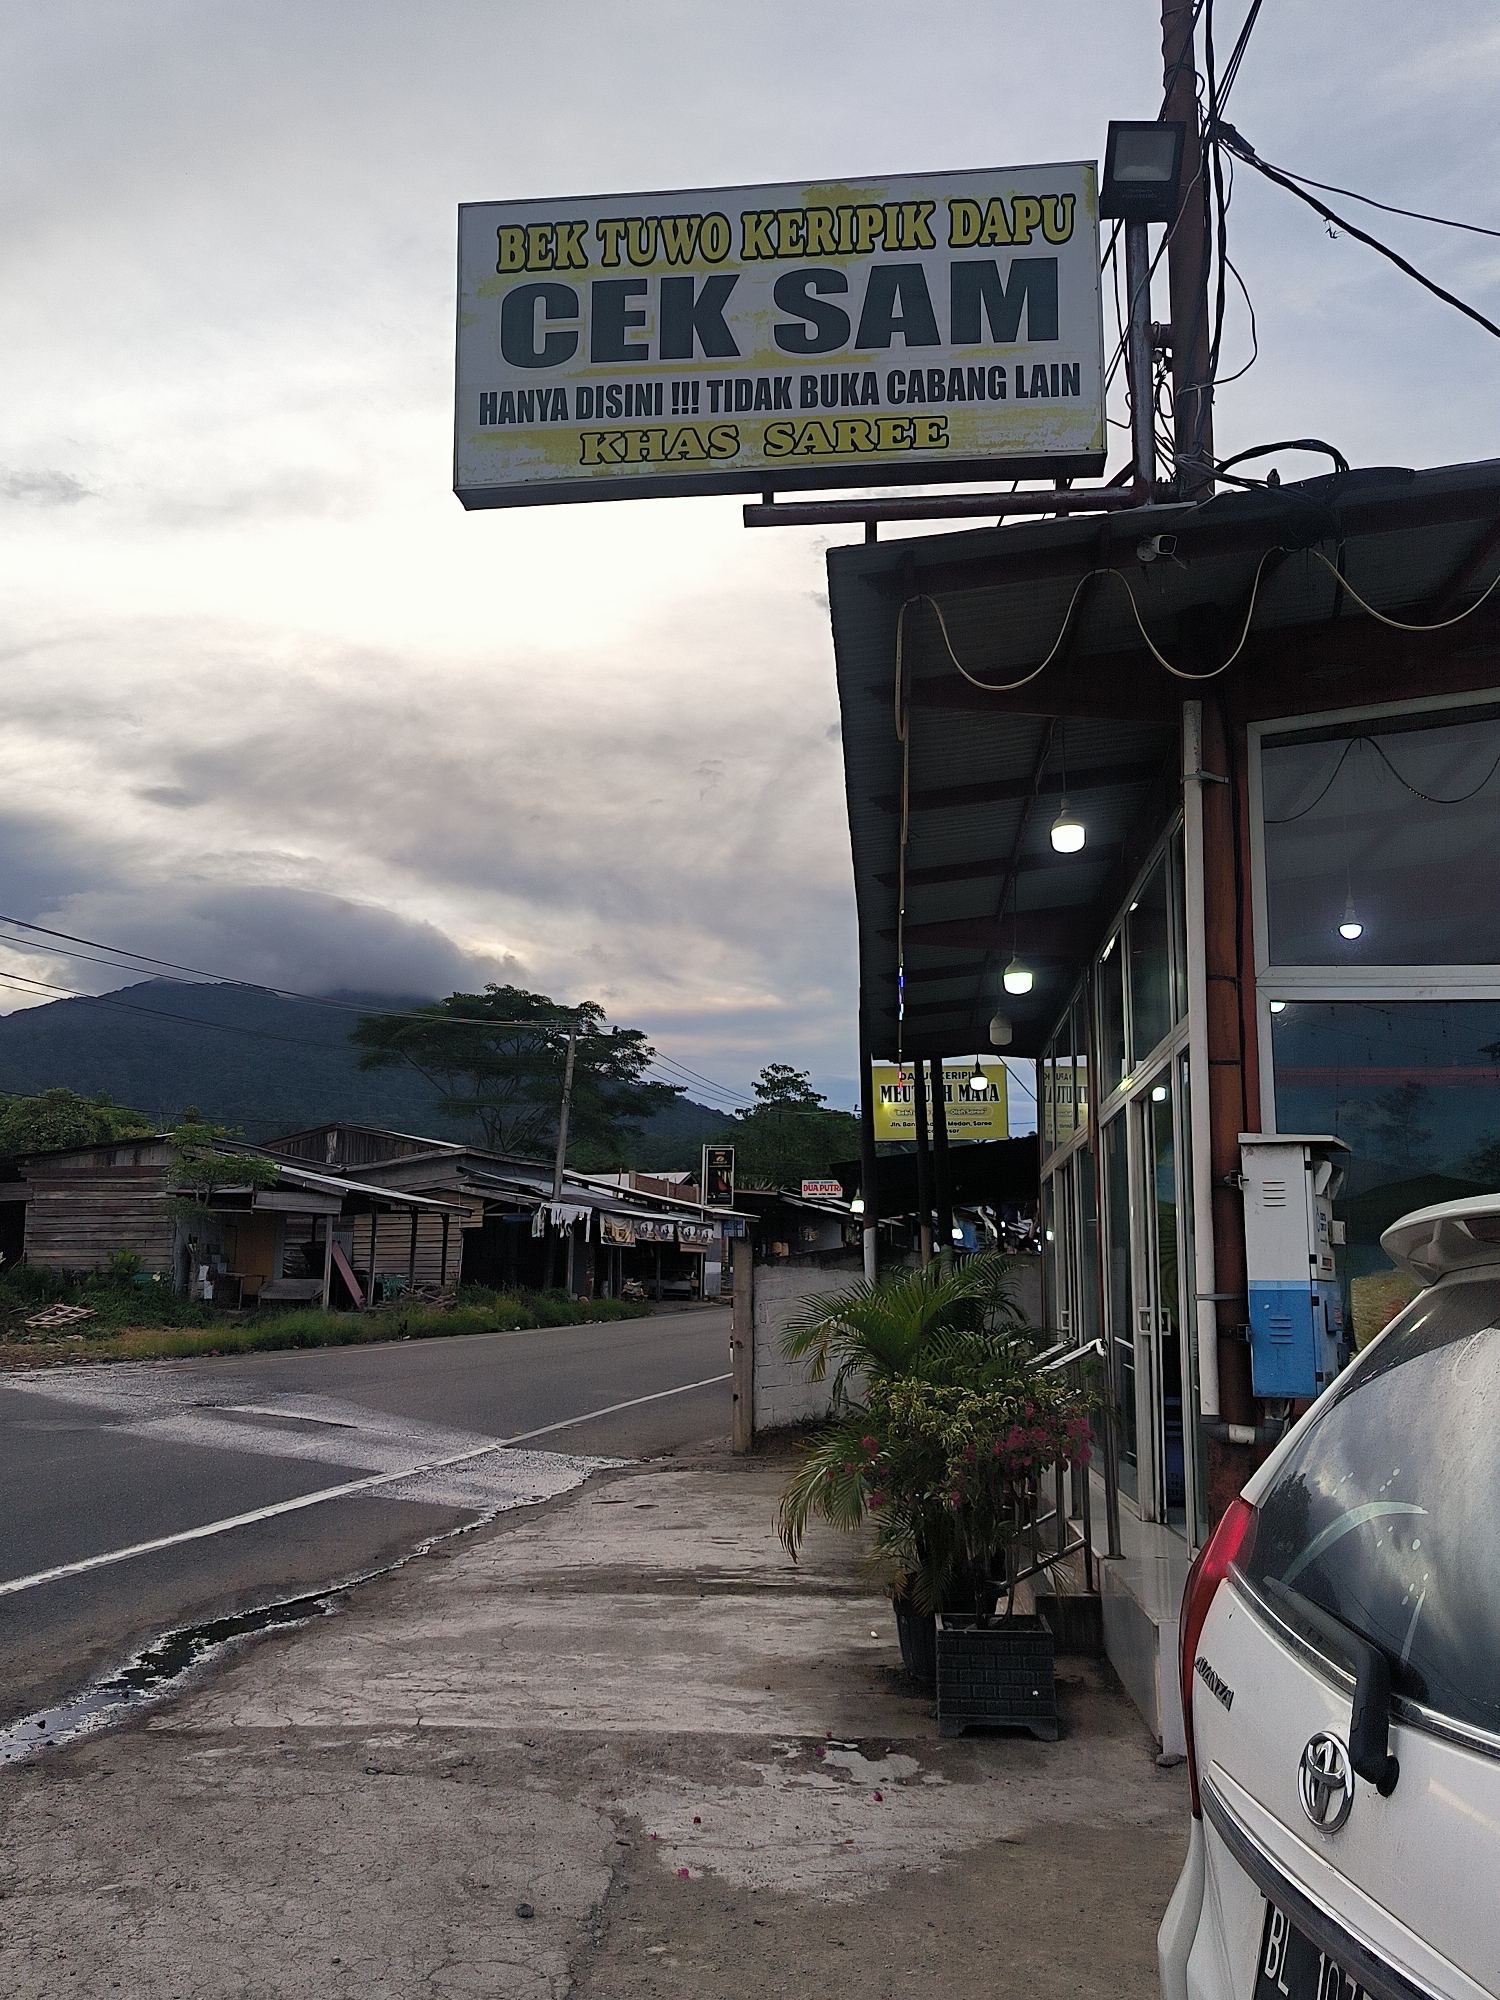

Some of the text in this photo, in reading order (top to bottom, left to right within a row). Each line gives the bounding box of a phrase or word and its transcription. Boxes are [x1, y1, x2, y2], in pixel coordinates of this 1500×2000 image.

[496, 195, 1076, 273] BEK TUWO KERIPIK DAPU
[500, 256, 1060, 369] CEK SAM
[479, 362, 1081, 425] HANYA DISINI !!! TIDAK BUKA CABANG LAIN
[580, 415, 950, 466] KHAS SAREE
[880, 1085, 953, 1102] MEUH
[803, 1184, 819, 1192] DUA
[1194, 1656, 1235, 1712] AVANZA
[1264, 1905, 1290, 1997] BL
